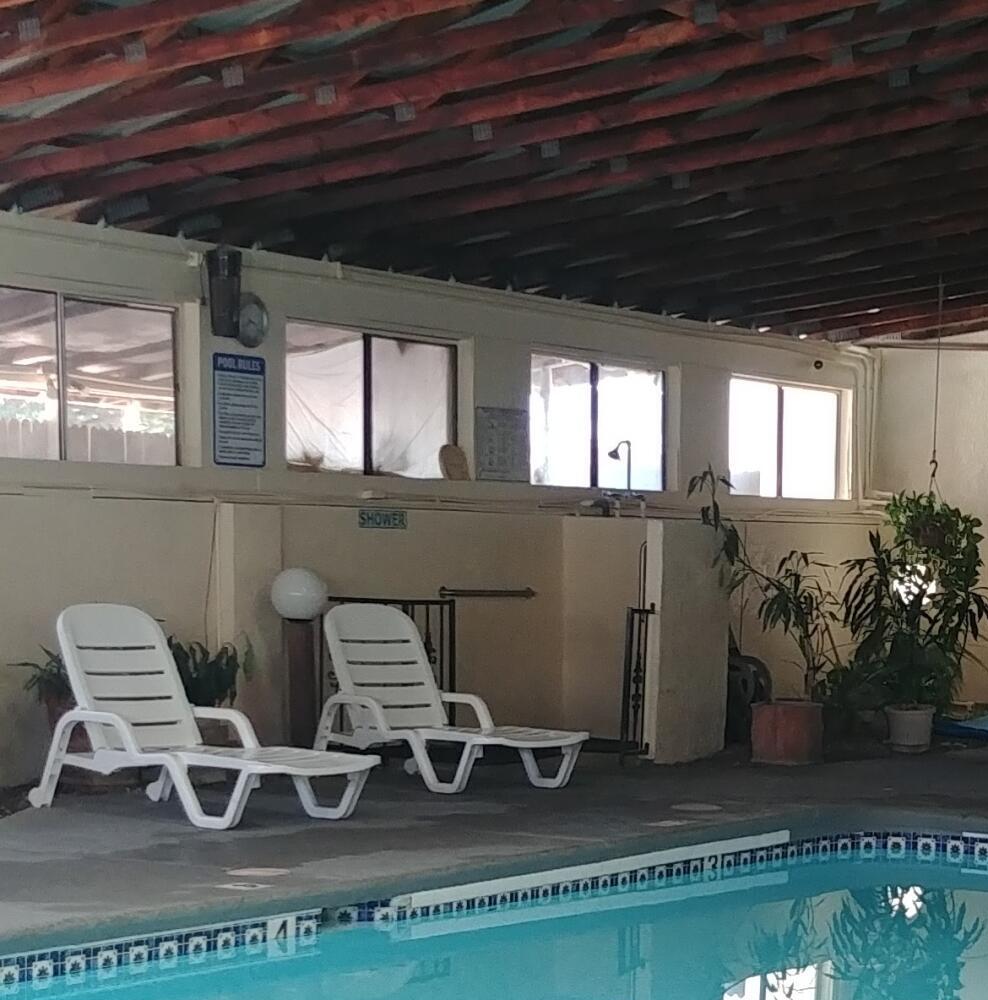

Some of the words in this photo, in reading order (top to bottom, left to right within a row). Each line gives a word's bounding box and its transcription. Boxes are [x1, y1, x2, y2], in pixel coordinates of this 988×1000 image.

[217, 356, 236, 369] POOL
[238, 358, 261, 371] RULES
[360, 511, 407, 527] SHOWER
